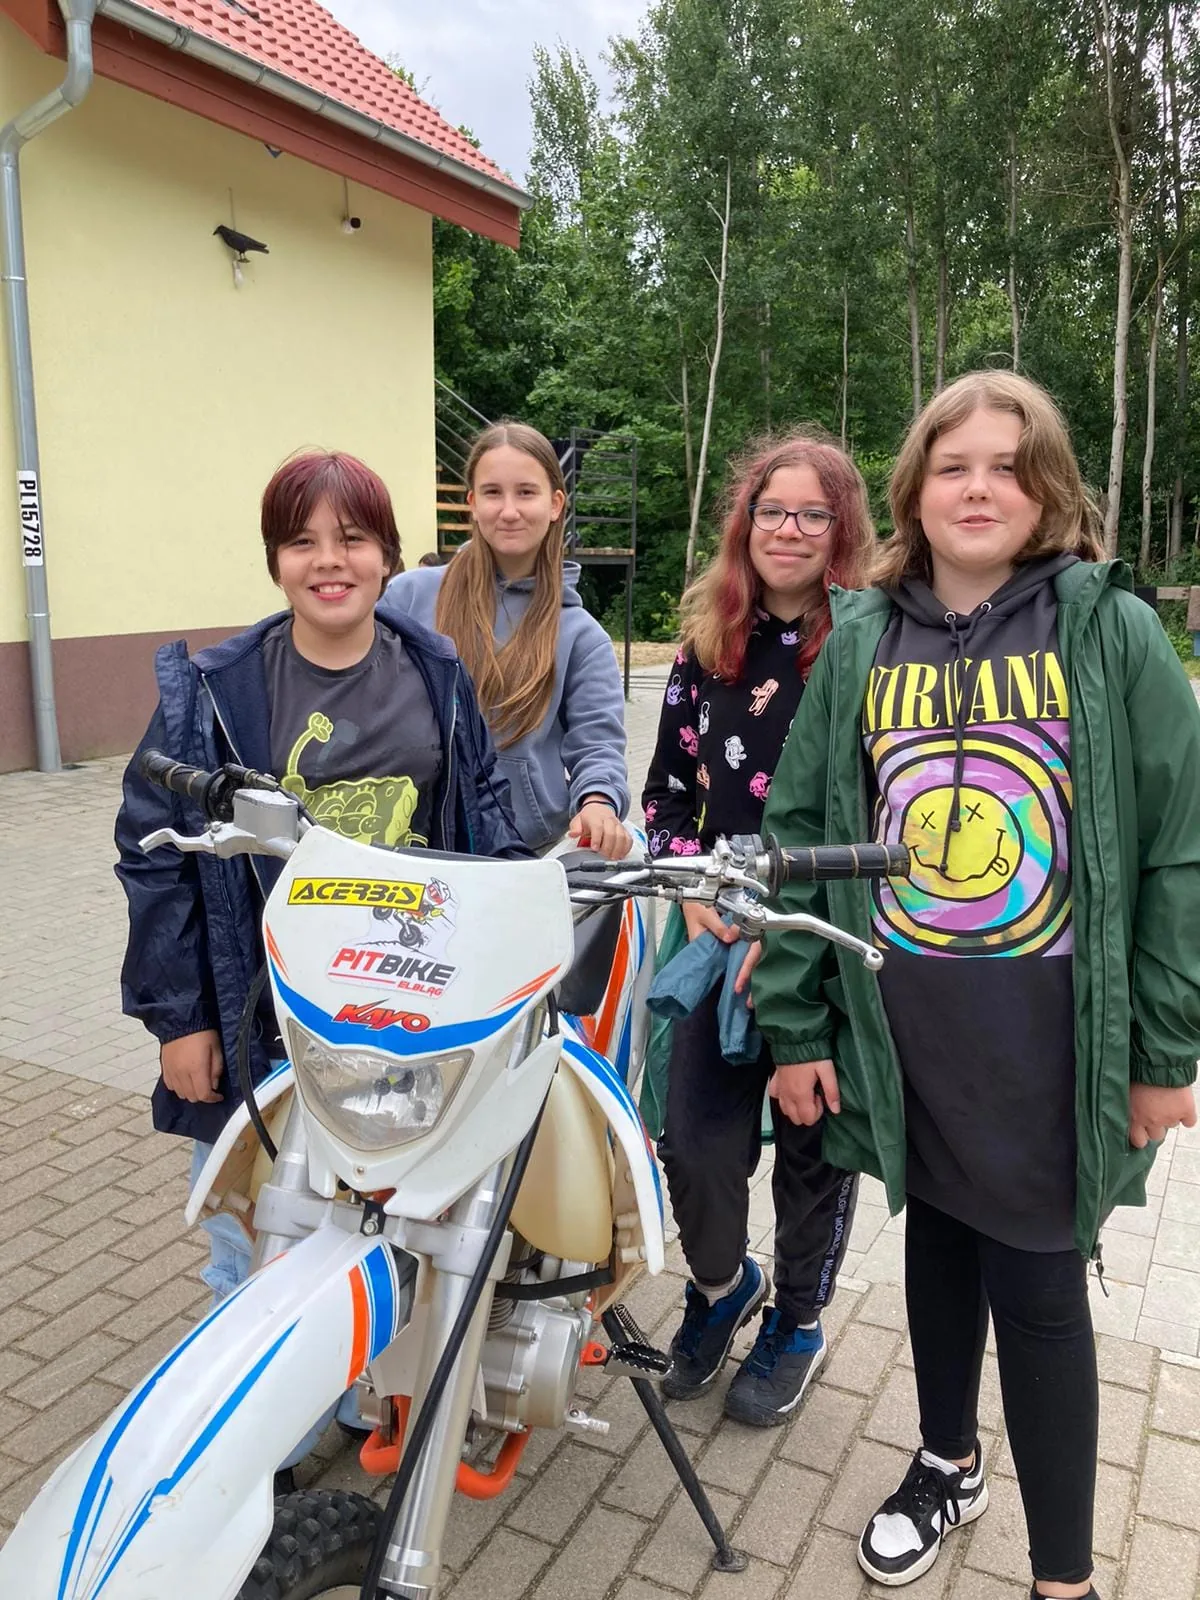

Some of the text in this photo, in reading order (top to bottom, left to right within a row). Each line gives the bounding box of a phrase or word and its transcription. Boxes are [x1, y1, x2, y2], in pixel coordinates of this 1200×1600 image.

[19, 480, 41, 557] PL15728
[331, 948, 456, 985] PITBIKE
[332, 997, 431, 1032] KAYO
[816, 1259, 834, 1301] MOONLIGHT
